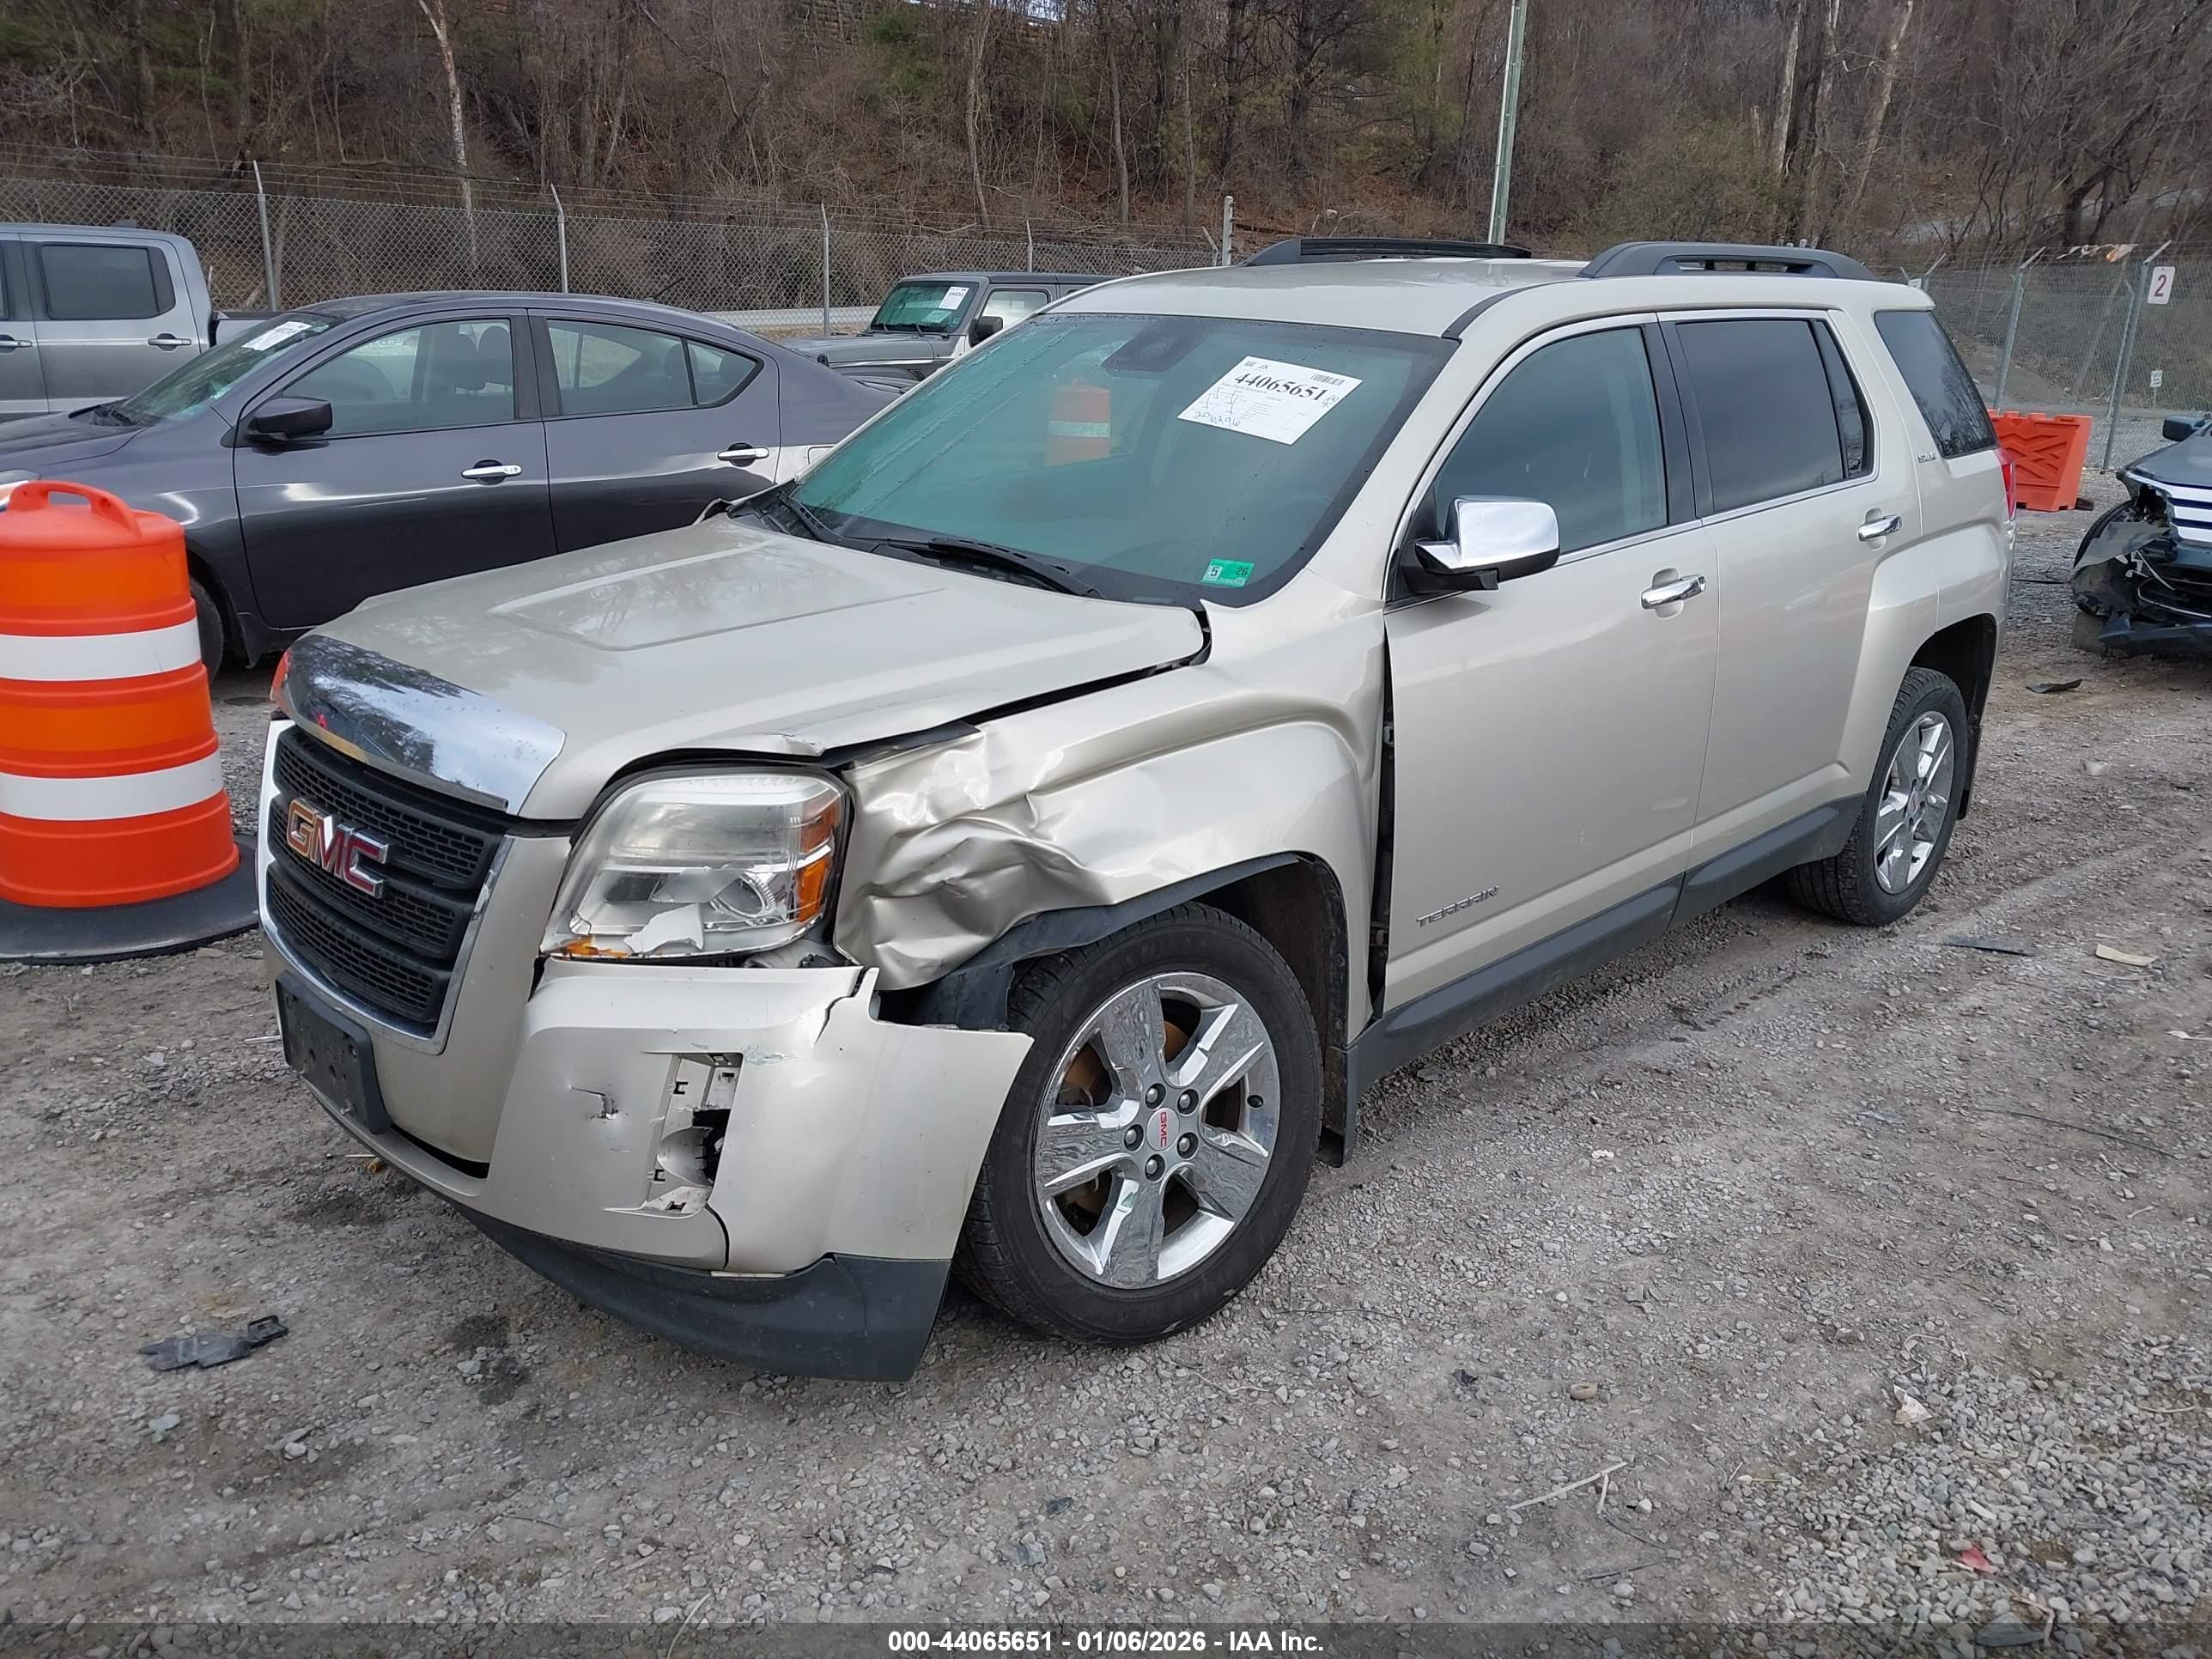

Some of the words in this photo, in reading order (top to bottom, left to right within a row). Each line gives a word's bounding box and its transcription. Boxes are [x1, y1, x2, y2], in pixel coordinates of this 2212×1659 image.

[2154, 273, 2167, 298] 2
[1233, 372, 1329, 401] 44065651
[1210, 566, 1219, 577] 5
[1236, 566, 1249, 576] 26
[286, 798, 389, 899] GMC
[1415, 885, 1500, 927] TERRAIN
